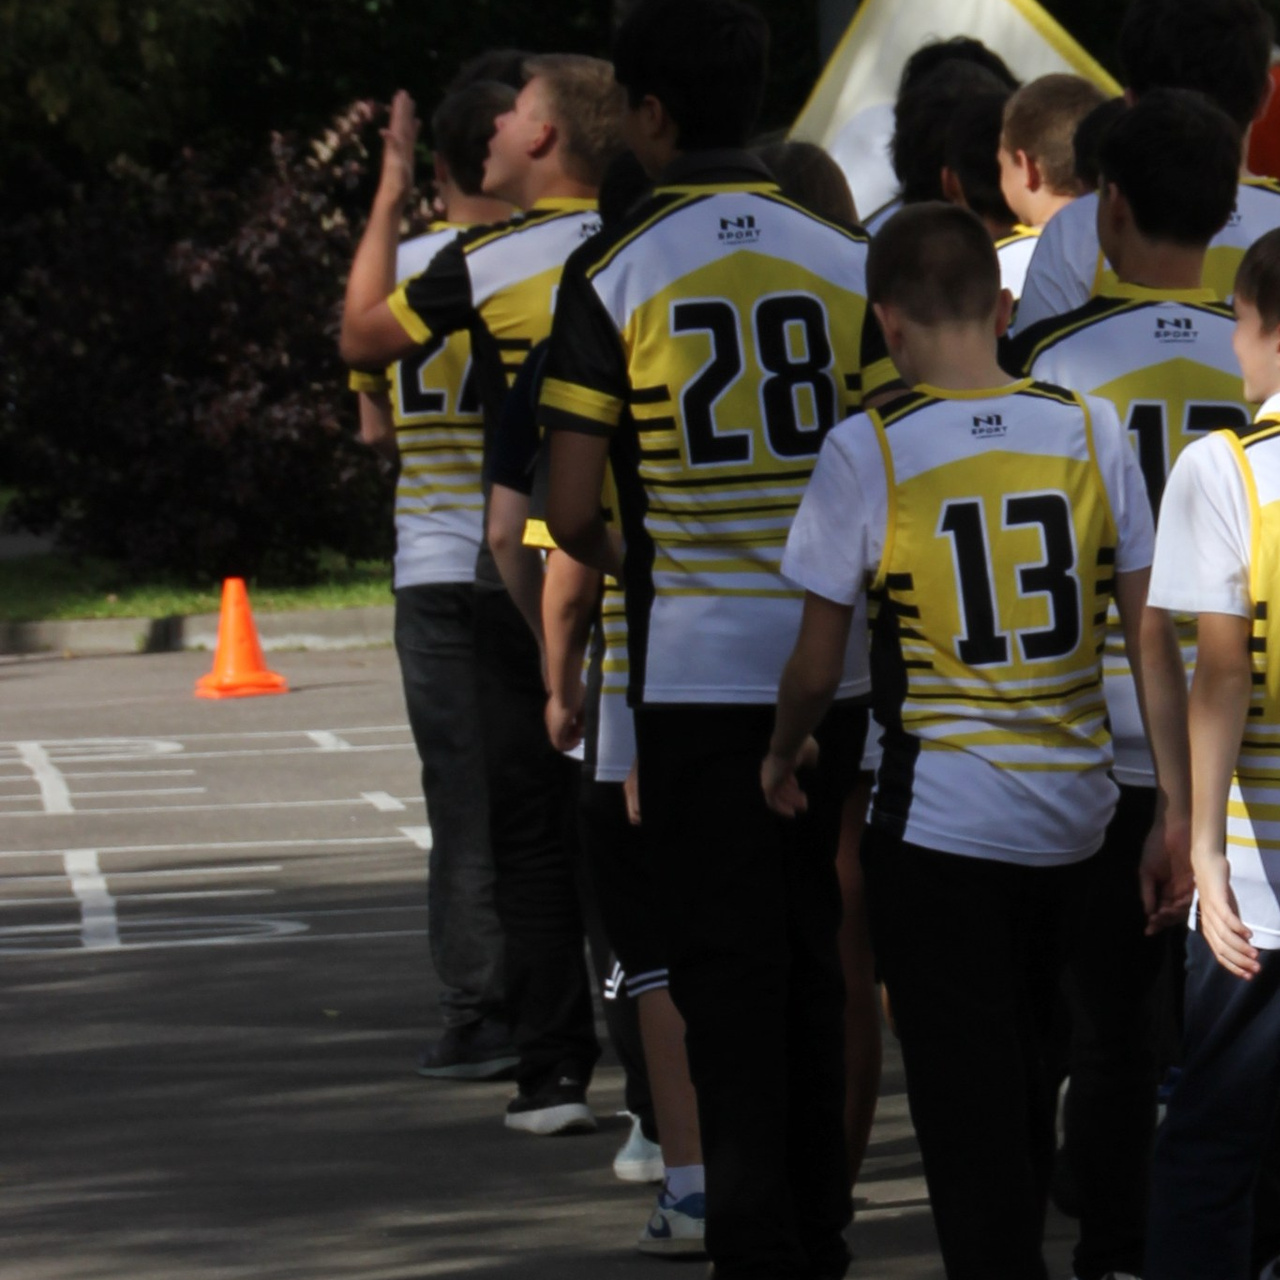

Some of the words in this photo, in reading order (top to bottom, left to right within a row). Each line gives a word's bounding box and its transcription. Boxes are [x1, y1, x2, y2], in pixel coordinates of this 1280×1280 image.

[717, 229, 761, 240] SPORT
[1154, 330, 1198, 339] SPORT
[669, 292, 837, 467] 28
[971, 426, 1007, 436] SPORT
[936, 490, 1081, 668] 13
